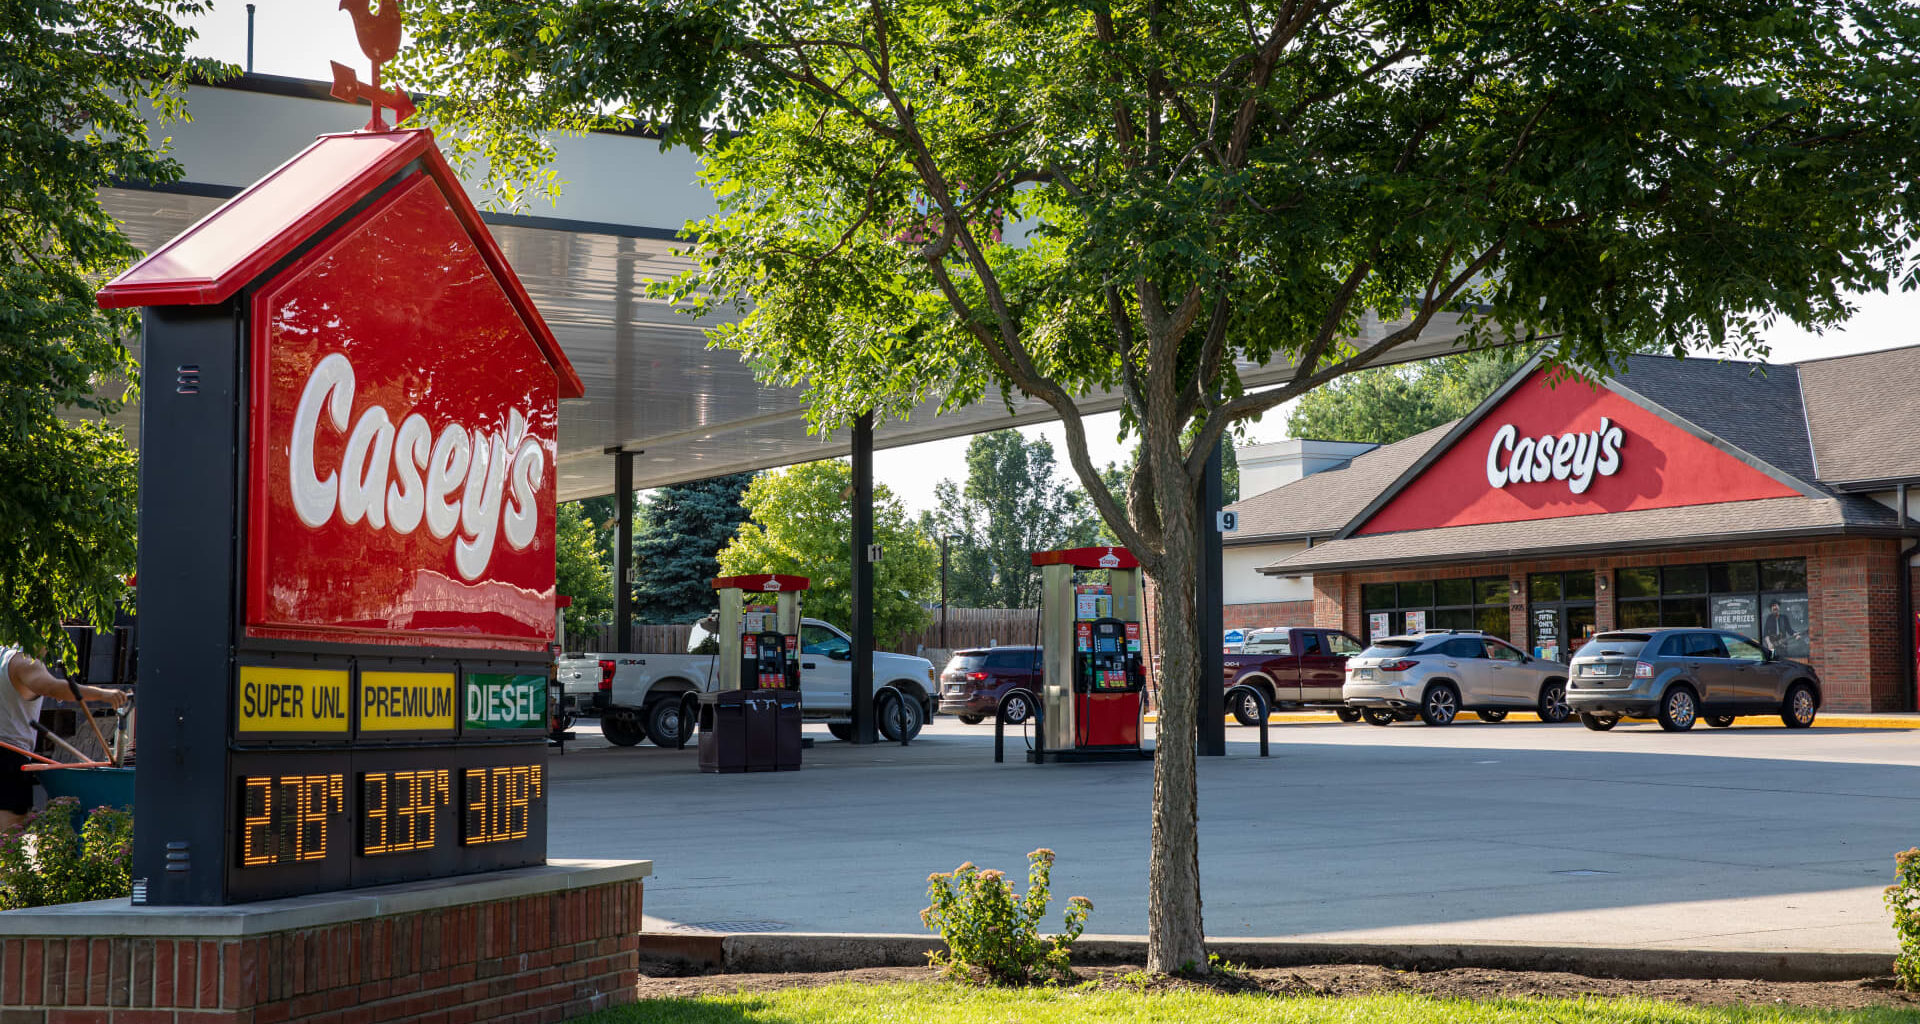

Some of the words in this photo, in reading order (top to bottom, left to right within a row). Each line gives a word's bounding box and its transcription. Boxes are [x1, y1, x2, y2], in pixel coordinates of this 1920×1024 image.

[290, 353, 544, 580] Casey's
[1486, 416, 1624, 495] Casey's
[1223, 513, 1235, 529] 9
[244, 682, 303, 718] SUPER
[312, 686, 344, 718] UNL
[364, 686, 451, 717] PREMIUM
[467, 683, 540, 721] DIESEL
